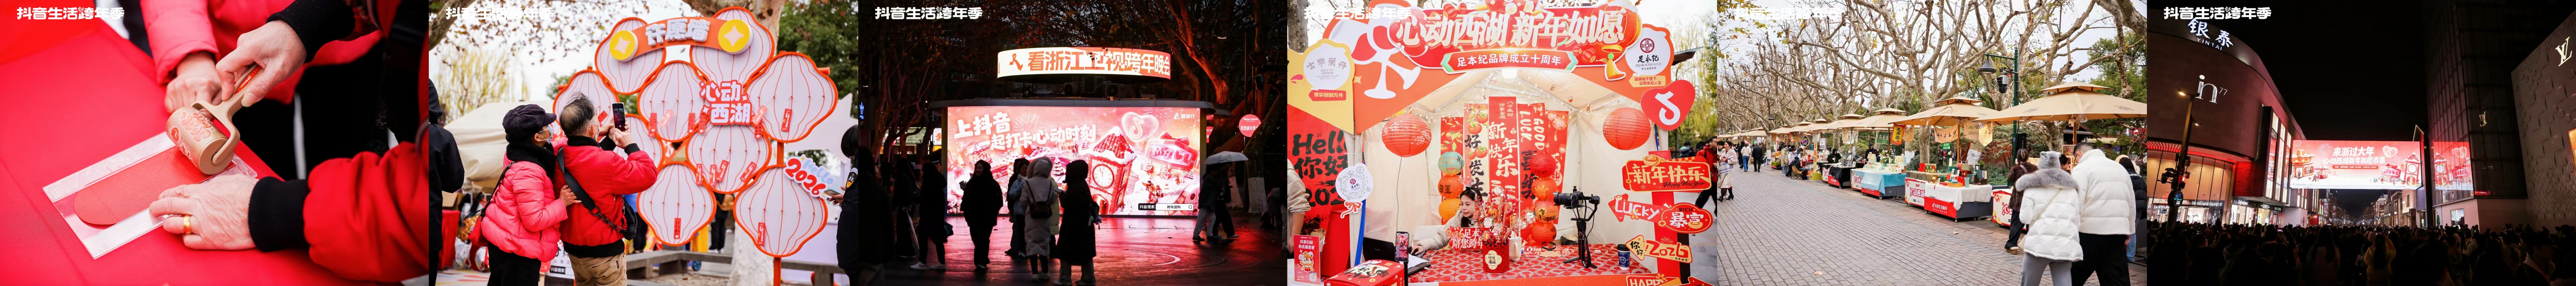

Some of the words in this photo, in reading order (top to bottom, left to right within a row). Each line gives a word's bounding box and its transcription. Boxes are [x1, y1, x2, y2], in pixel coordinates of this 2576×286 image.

[646, 18, 710, 46] 许愿墙
[1396, 10, 1511, 47] 心动西湖
[1510, 8, 1627, 47] 新年如愿
[2188, 18, 2233, 48] 银泰
[2197, 37, 2222, 50] YINTAI
[1028, 50, 1170, 76] 看浙江卫视跨年晚会
[1306, 57, 1347, 70] 古早萬丹
[1457, 53, 1561, 67] 足本纪品牌成立十周年
[1638, 55, 1659, 63] 足本纪
[701, 81, 741, 102] 心动
[711, 103, 751, 123] 西湖
[954, 112, 1011, 139] 上抖音
[978, 124, 1096, 150] 一起打卡心动时刻
[1519, 111, 1532, 142] LUCK
[1533, 118, 1545, 150] GOOD
[1292, 130, 1348, 156] Hell
[1489, 121, 1519, 177] 新年快乐
[2332, 146, 2374, 157] 来浙过大年
[1294, 155, 1348, 179] 你好
[2323, 156, 2385, 164] 心动西湖新年如愿市集
[785, 158, 826, 196] 2026
[1629, 163, 1710, 184] 新年快乐
[1910, 189, 1924, 198] 心动西湖
